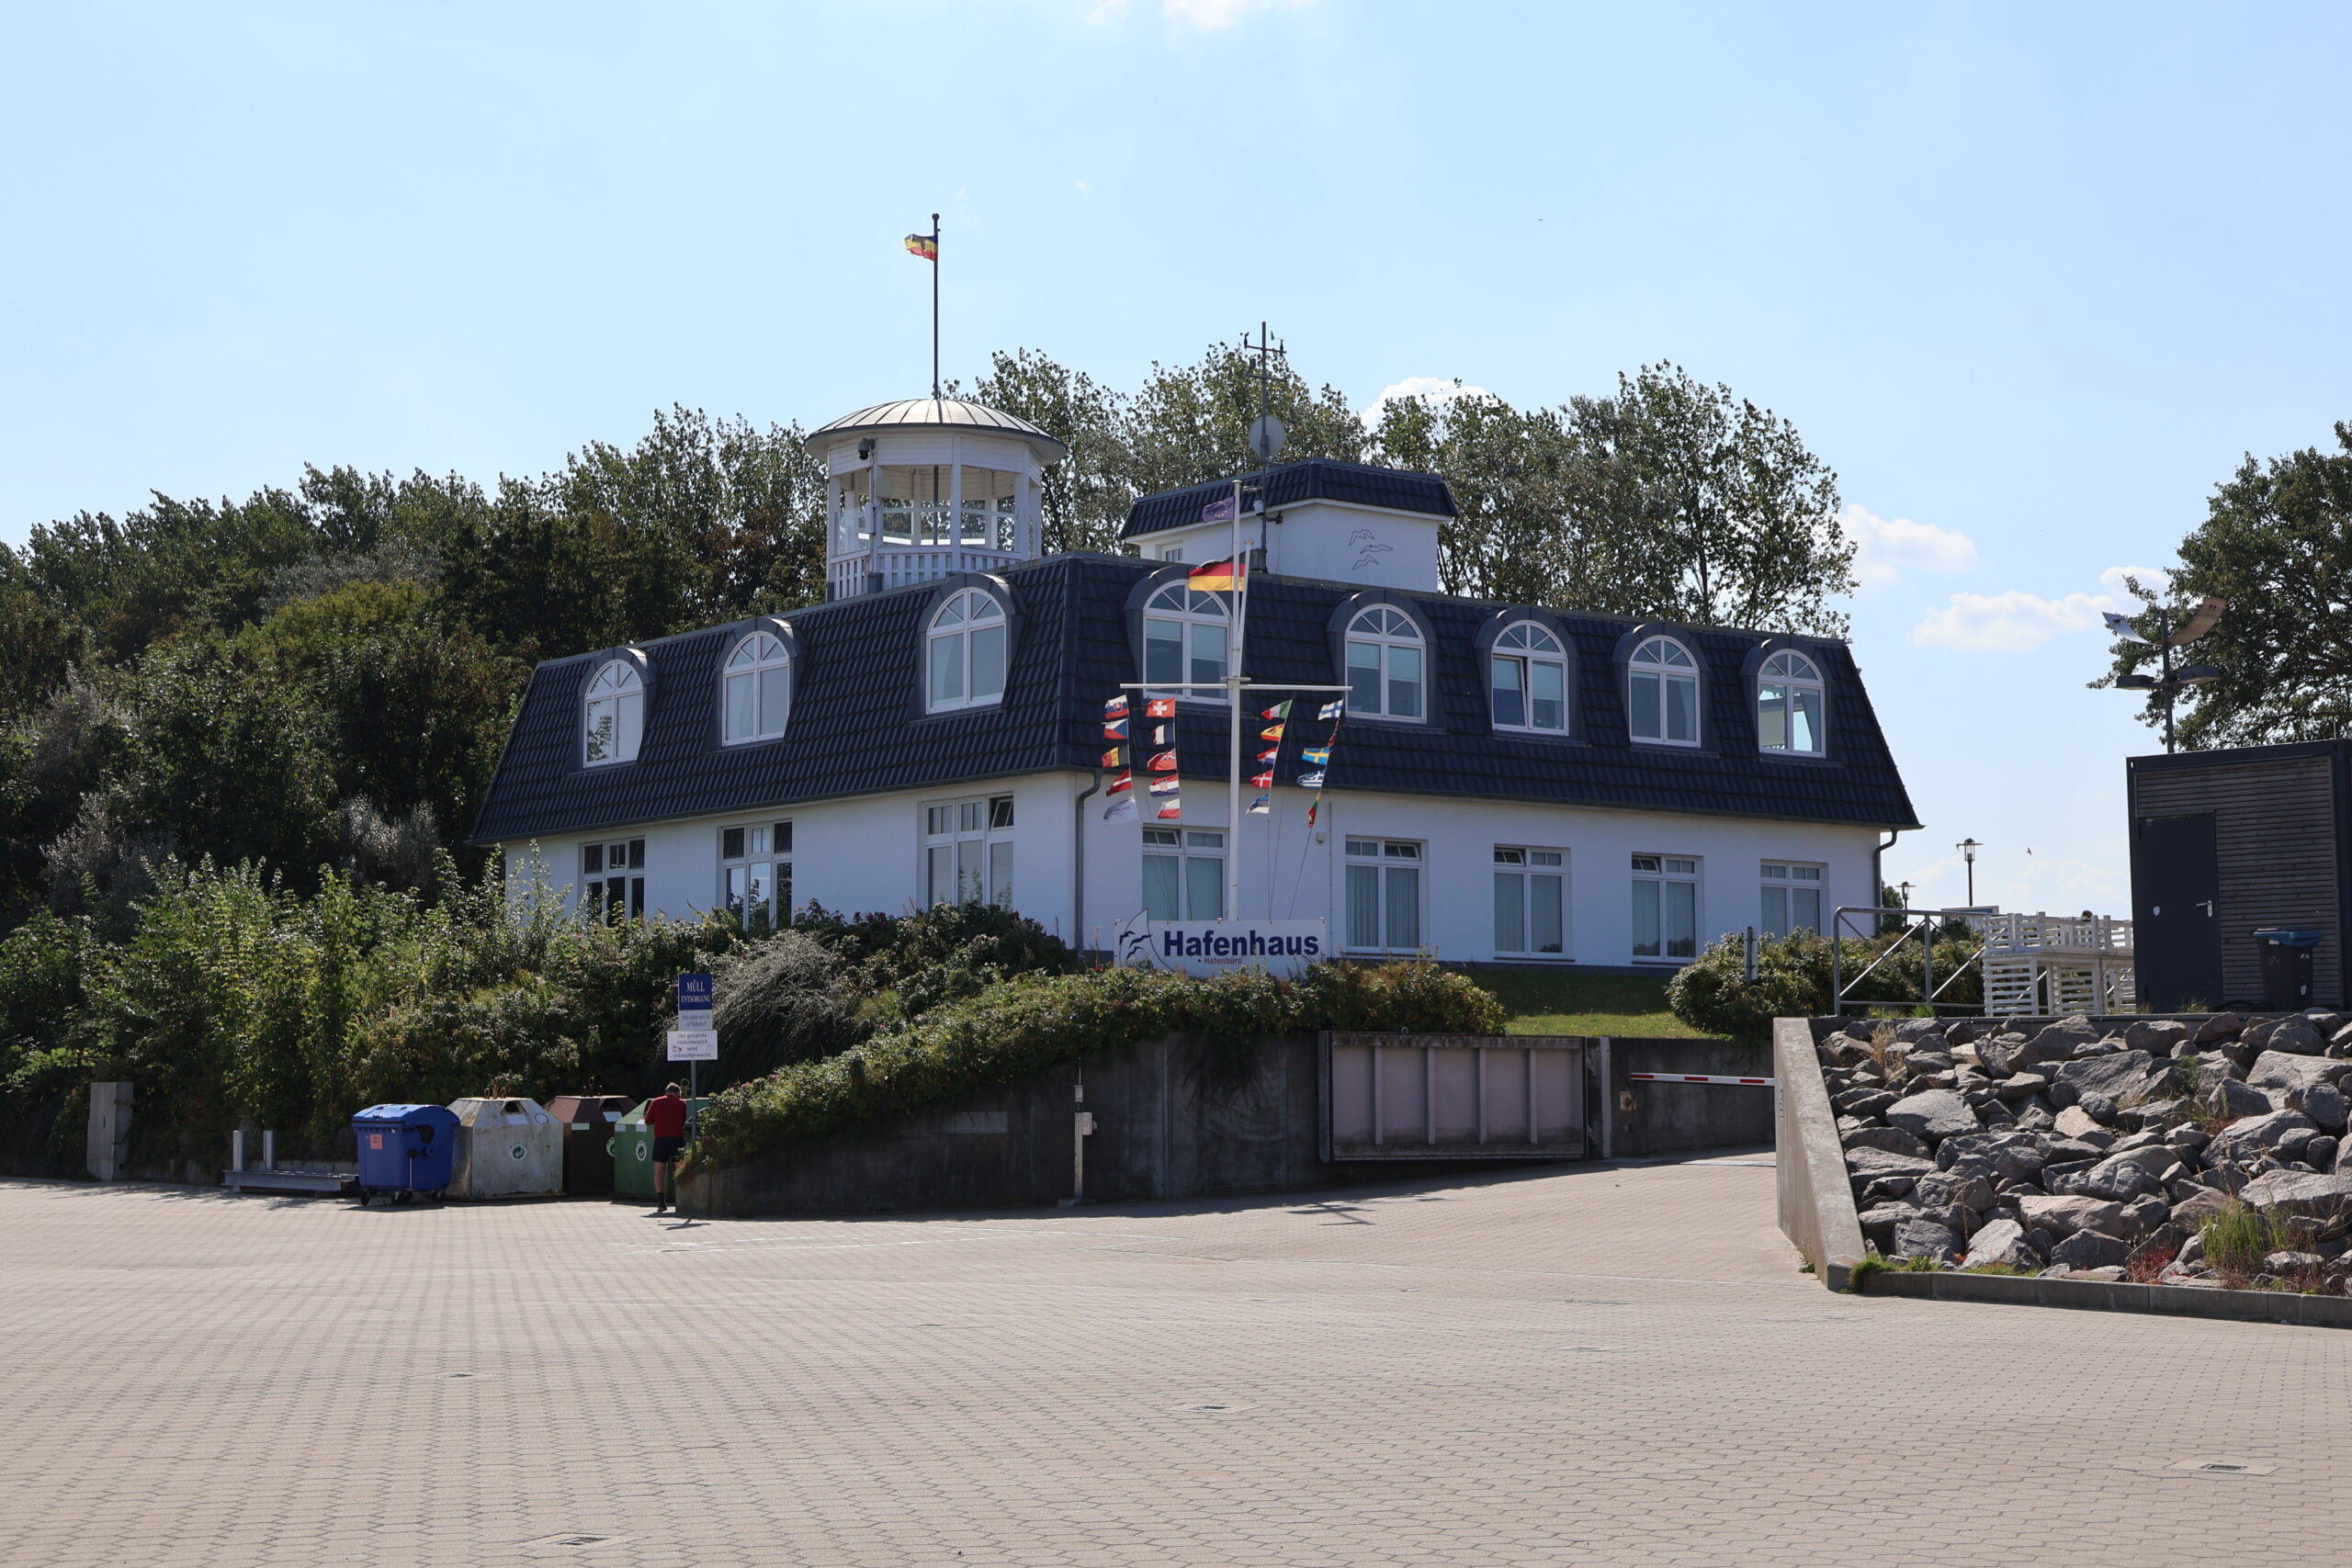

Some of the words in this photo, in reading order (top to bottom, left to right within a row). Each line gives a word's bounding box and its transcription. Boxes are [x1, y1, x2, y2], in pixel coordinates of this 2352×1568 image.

[1164, 930, 1319, 956] Hafenhaus
[1204, 956, 1242, 964] Hafenbüro
[686, 979, 706, 993] MÜLL
[681, 995, 711, 1003] ENTSORGUNG
